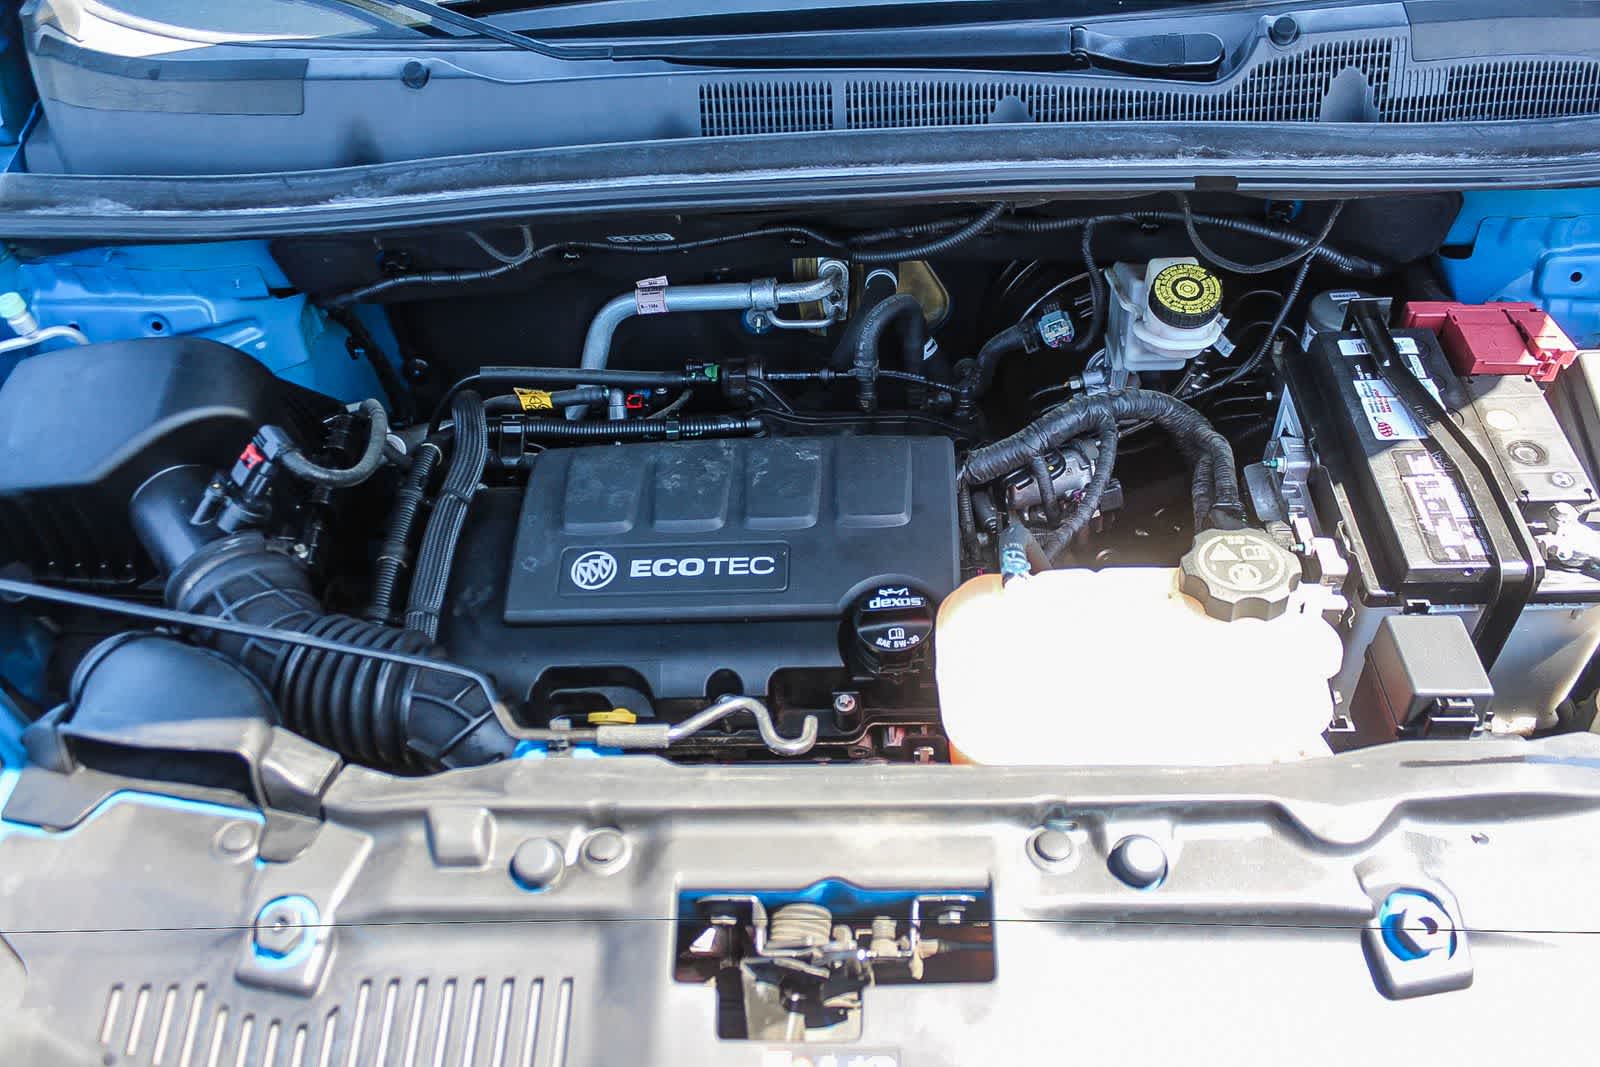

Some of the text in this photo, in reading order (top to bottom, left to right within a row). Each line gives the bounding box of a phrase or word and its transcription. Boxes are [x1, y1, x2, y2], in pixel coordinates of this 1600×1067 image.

[629, 556, 775, 577] ECOTEC
[869, 597, 922, 609] dexos
[875, 635, 920, 648] SAE 5W-30
